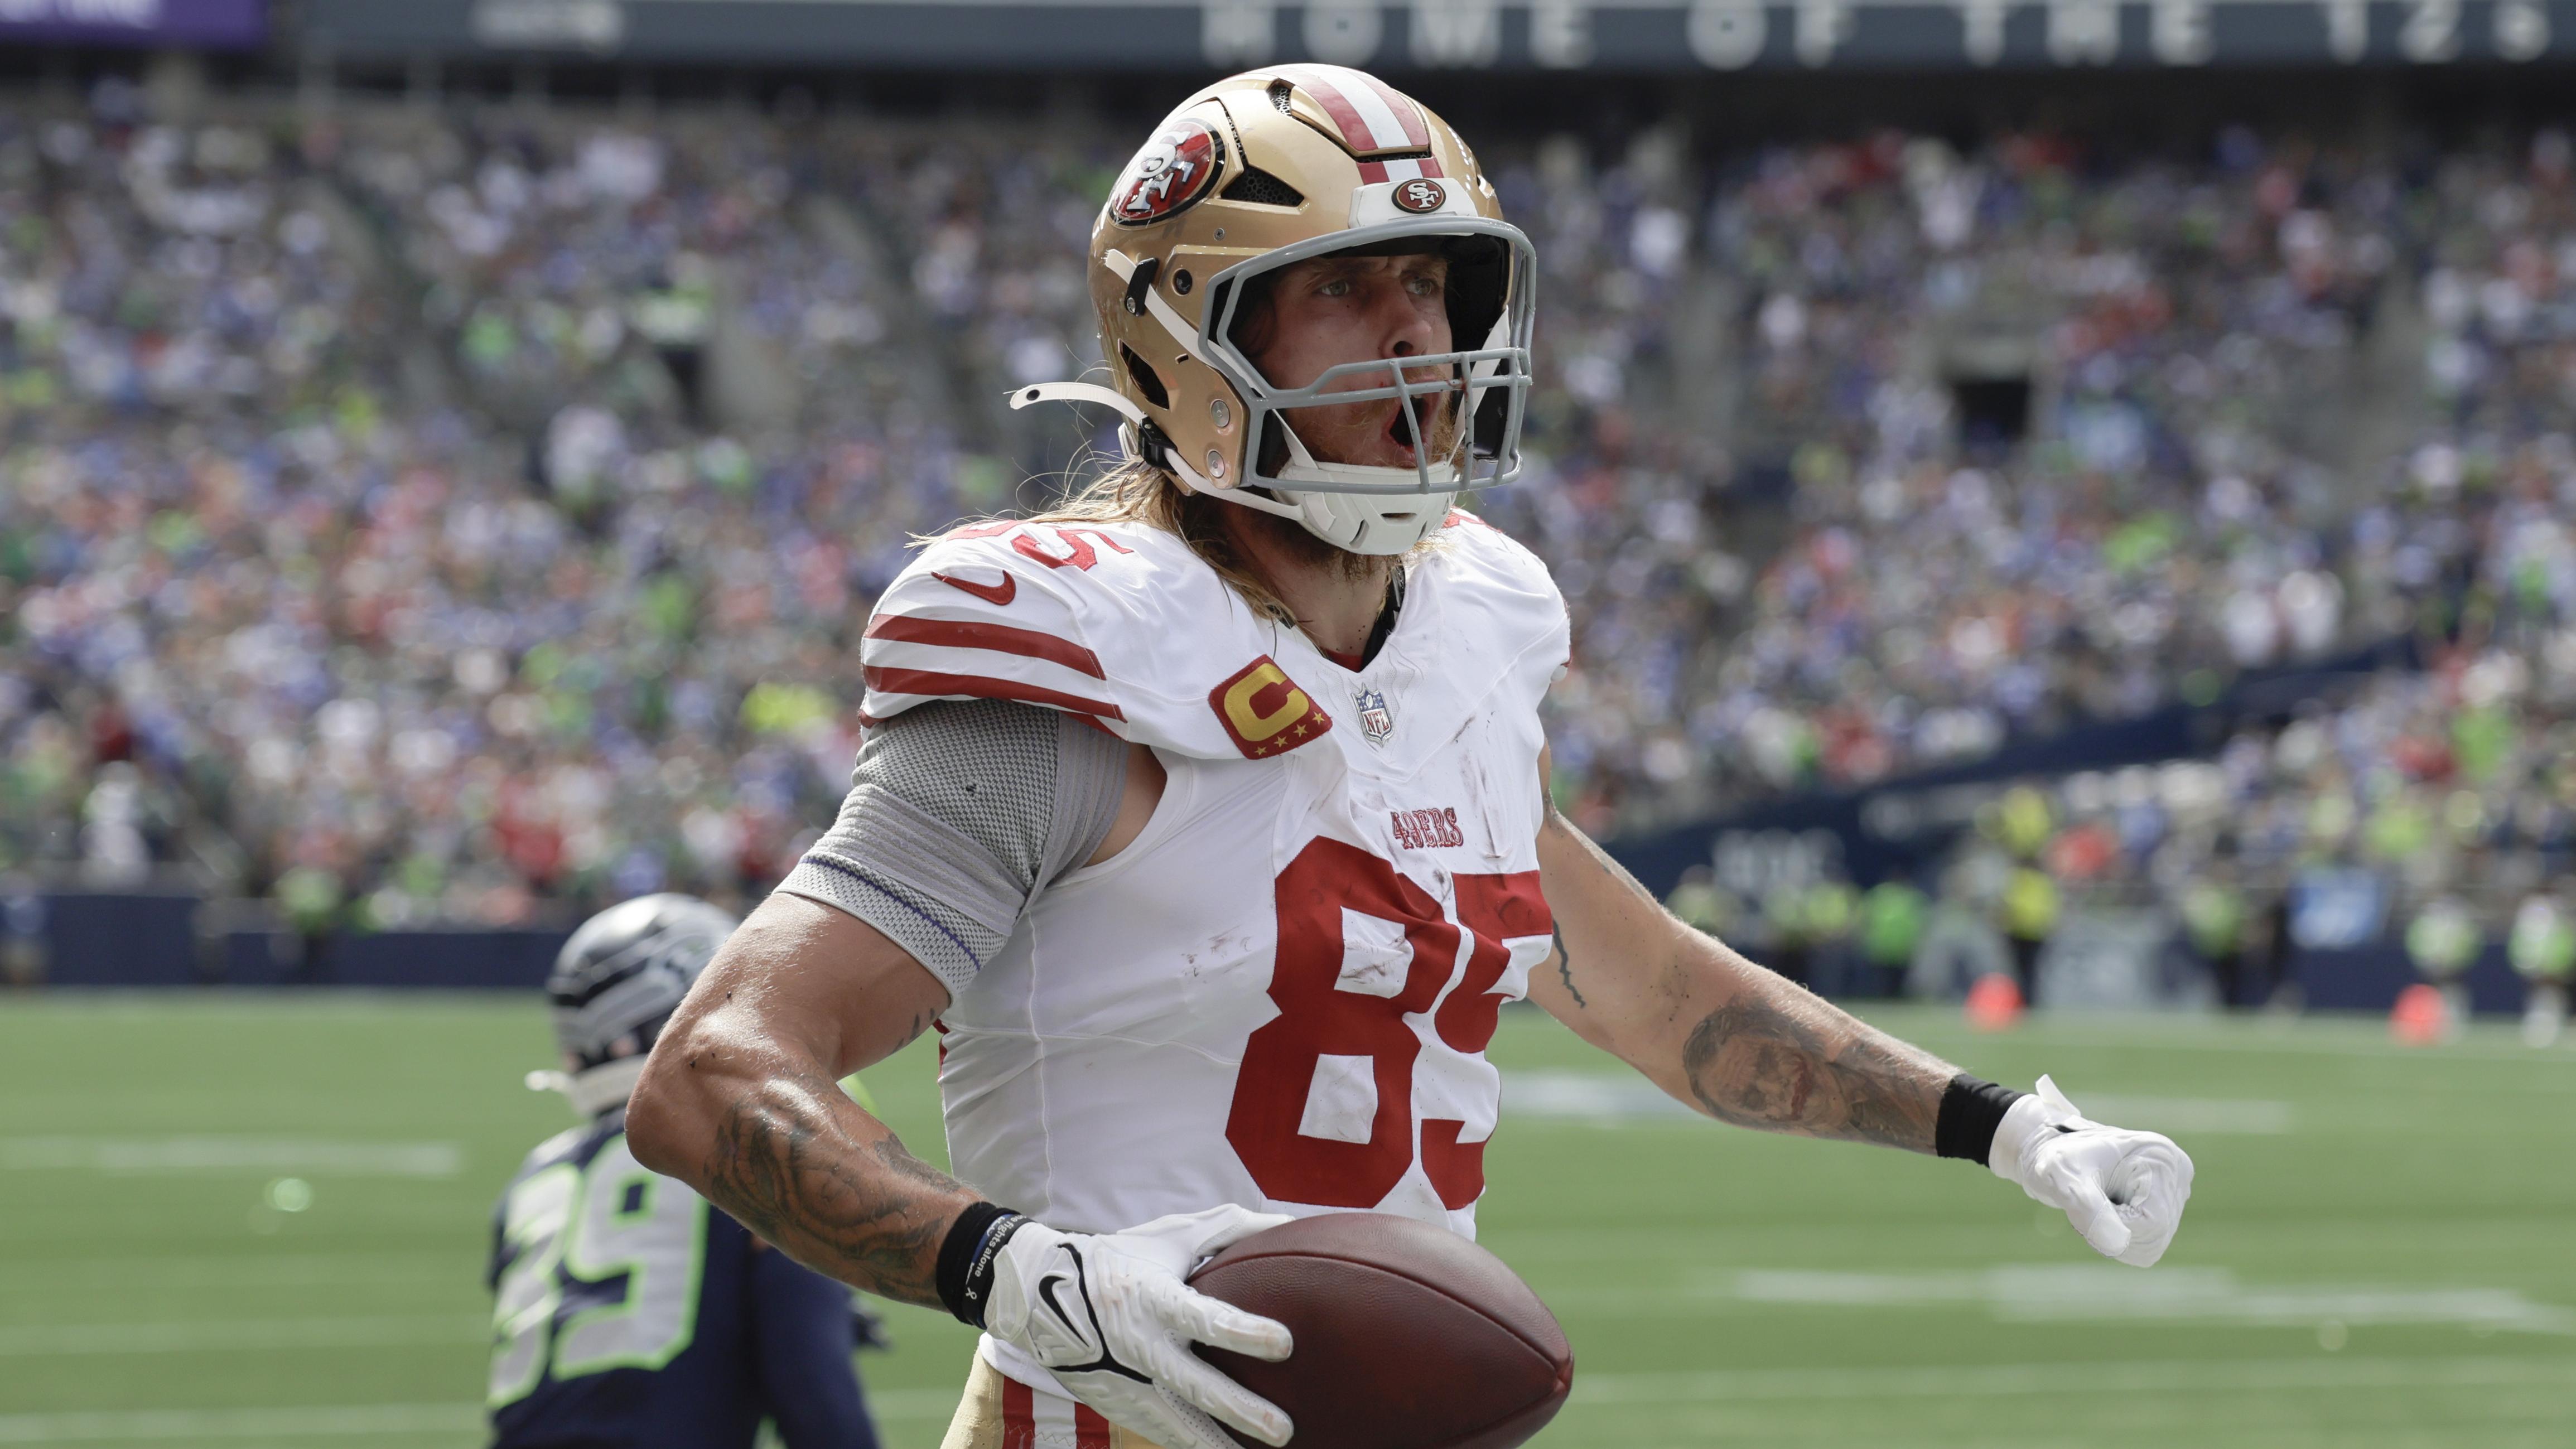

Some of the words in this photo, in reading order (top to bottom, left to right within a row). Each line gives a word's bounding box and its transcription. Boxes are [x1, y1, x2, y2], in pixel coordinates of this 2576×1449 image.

[1200, 2, 1595, 69] HOME
[1686, 2, 1859, 69] OF
[1952, 2, 2217, 67] THE
[1407, 182, 1439, 208] SF
[1224, 663, 1310, 742] C
[1364, 710, 1390, 734] NFL
[1391, 807, 1464, 850] 49ERS
[1225, 835, 1553, 1211] 85
[989, 1220, 1014, 1247] fights
[975, 1247, 992, 1277] alone
